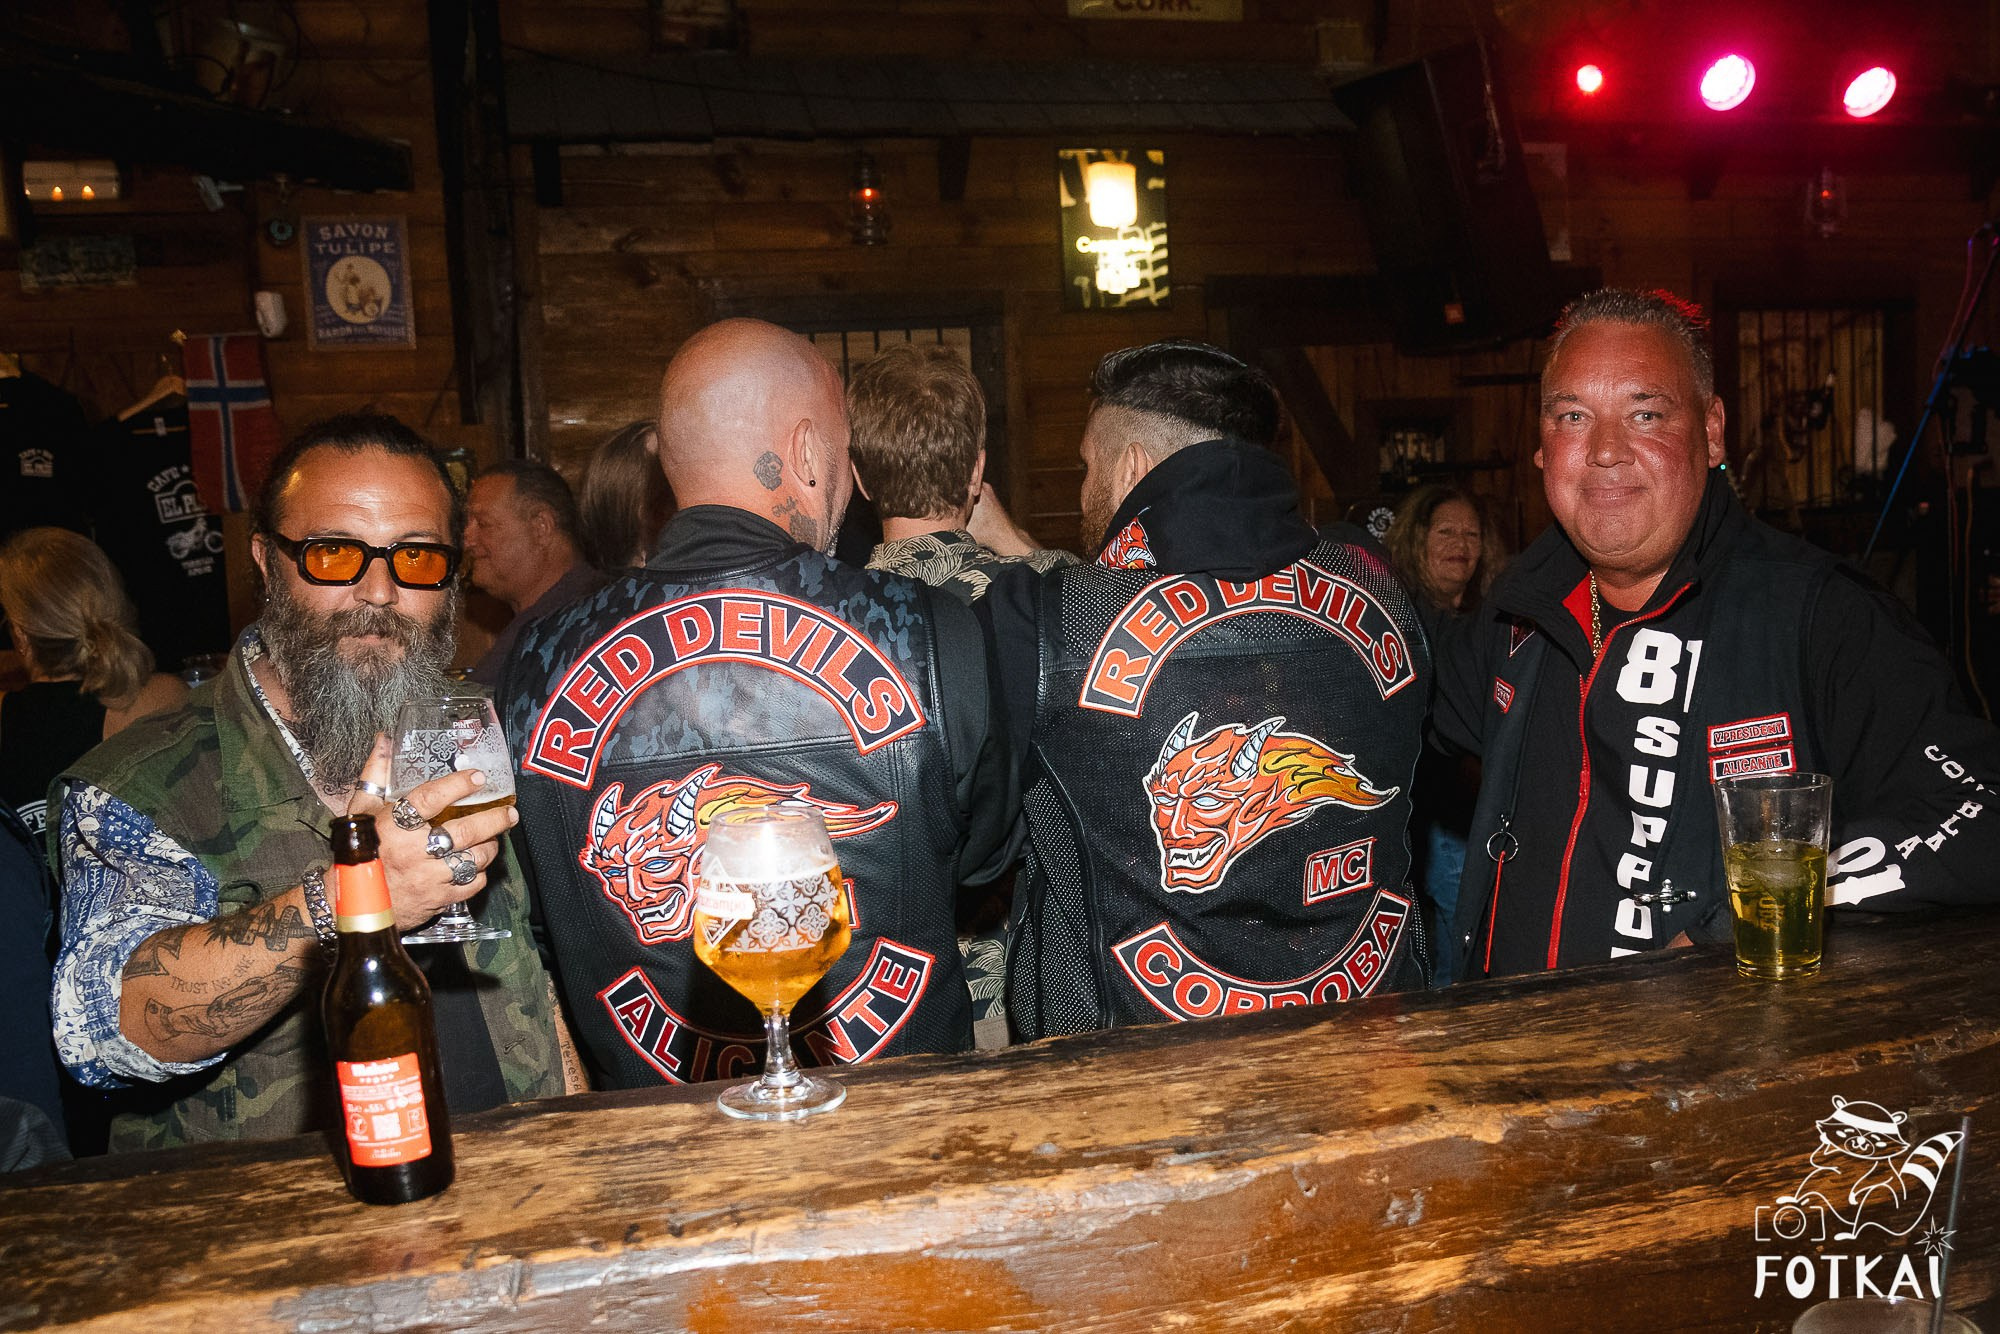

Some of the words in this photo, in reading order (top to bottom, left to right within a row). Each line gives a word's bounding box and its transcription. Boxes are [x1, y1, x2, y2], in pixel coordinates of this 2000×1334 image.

[314, 241, 396, 255] TULIPE
[319, 223, 388, 241] SAVON
[1091, 579, 1209, 704] RED
[1215, 562, 1403, 683] DEVILS
[536, 633, 655, 778] RED
[664, 598, 906, 734] DEVILS
[1615, 627, 1703, 713] 81
[1714, 721, 1784, 743] V.PRESIDENT
[1722, 753, 1784, 776] ALICANTE
[1610, 715, 1682, 959] SUPPO
[1309, 848, 1366, 896] MC
[170, 975, 208, 994] TRUST
[211, 976, 231, 992] NO
[233, 954, 256, 978] ONE
[616, 955, 921, 1083] ALICNTE
